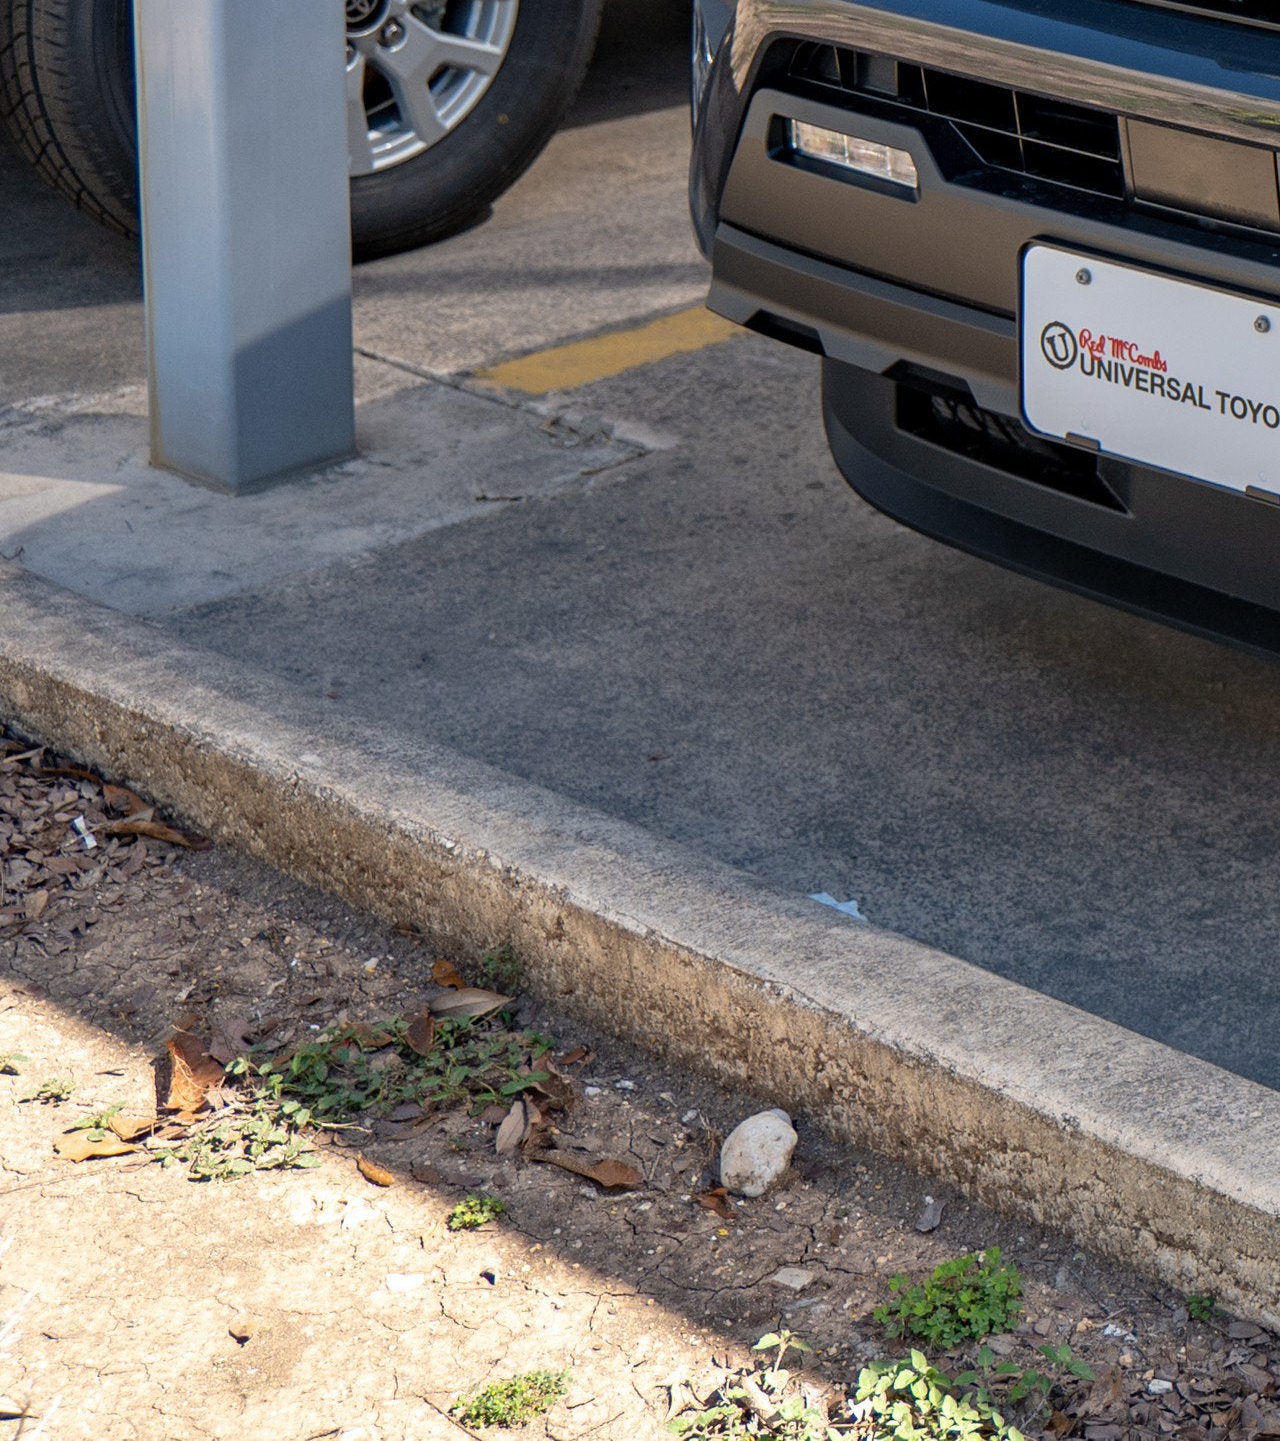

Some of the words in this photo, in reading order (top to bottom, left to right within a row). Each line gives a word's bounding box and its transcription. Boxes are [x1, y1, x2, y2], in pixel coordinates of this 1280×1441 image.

[1079, 328, 1105, 361] Red
[1107, 336, 1168, 372] McCombs
[1080, 352, 1212, 411] UNIVERSAL
